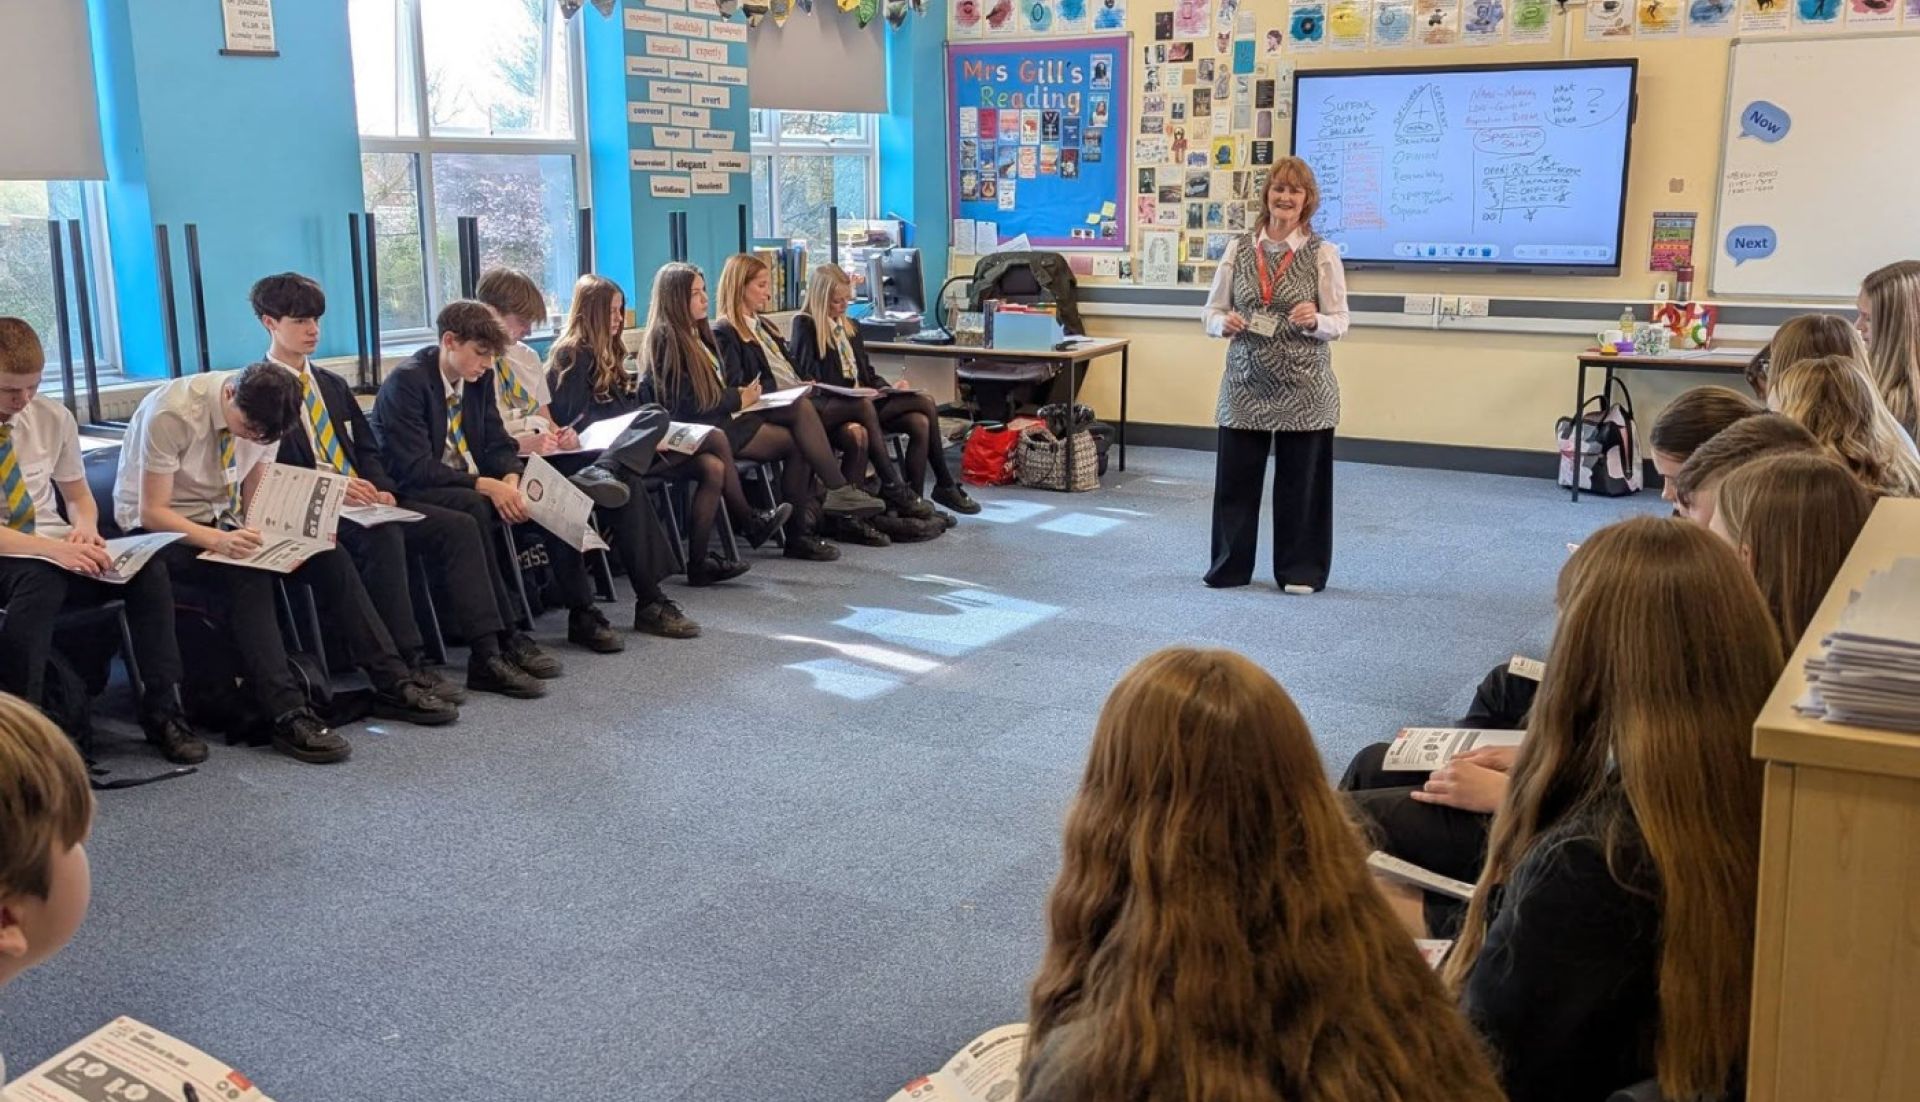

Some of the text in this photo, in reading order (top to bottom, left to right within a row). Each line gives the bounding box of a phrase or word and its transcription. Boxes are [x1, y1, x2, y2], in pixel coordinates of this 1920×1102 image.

[963, 59, 1083, 84] Mrs Gill's
[980, 85, 1081, 116] Reading
[1750, 110, 1781, 134] Now
[676, 158, 707, 171] elegant
[1734, 237, 1768, 249] Next
